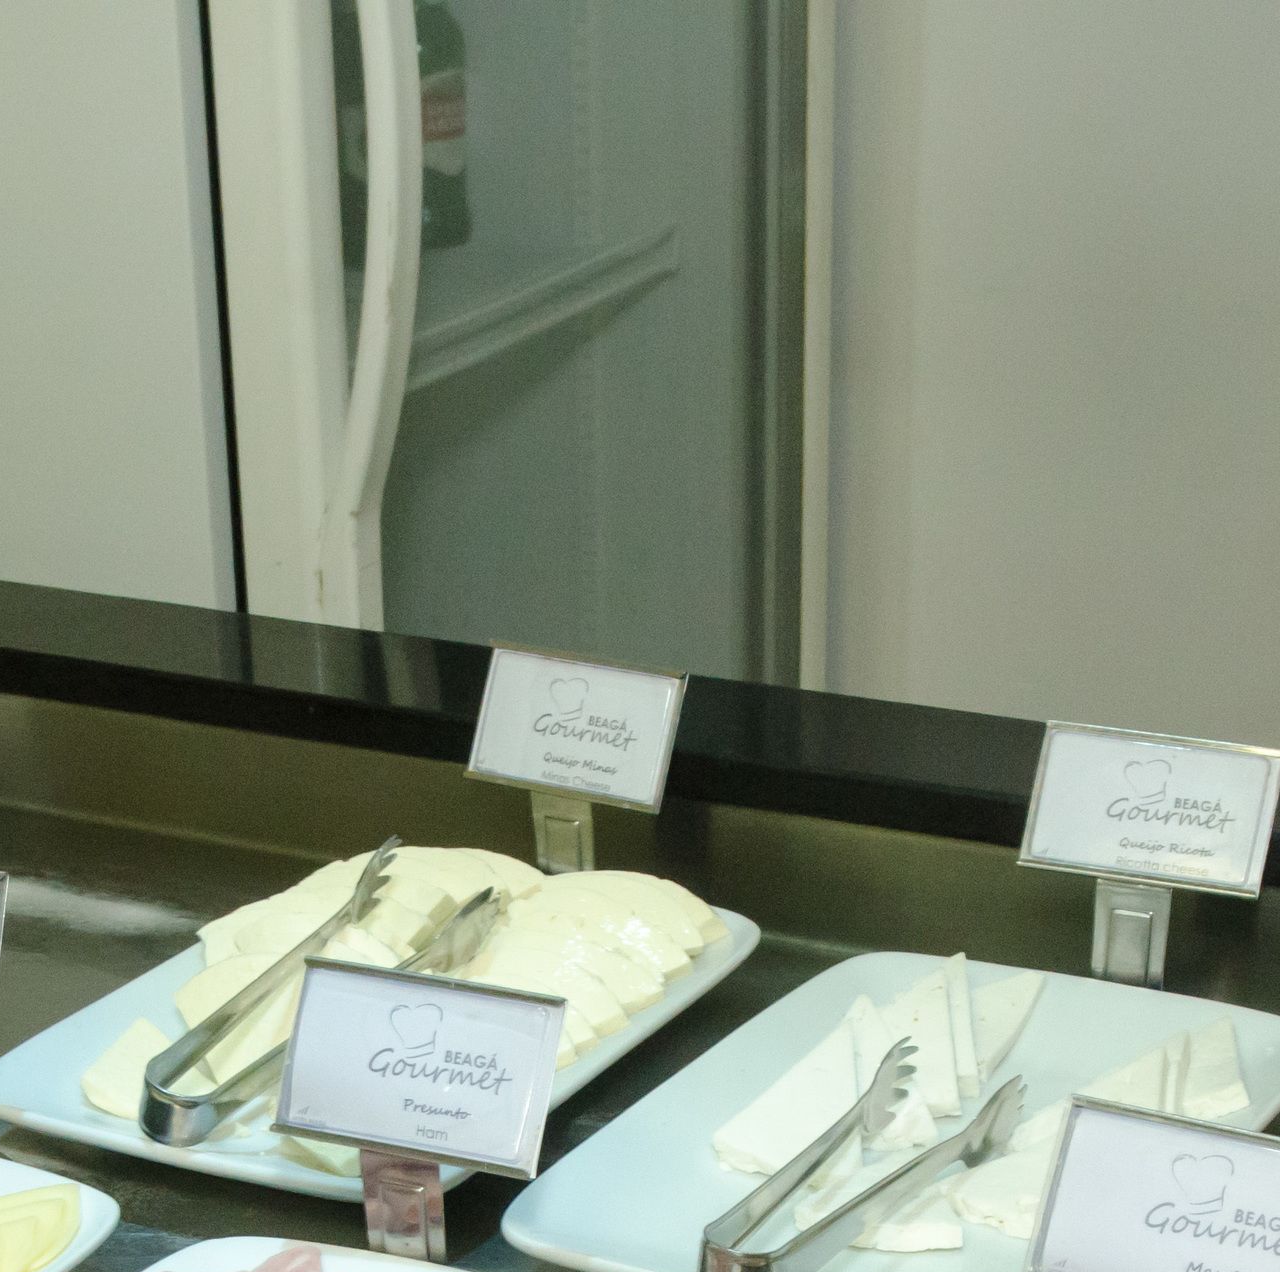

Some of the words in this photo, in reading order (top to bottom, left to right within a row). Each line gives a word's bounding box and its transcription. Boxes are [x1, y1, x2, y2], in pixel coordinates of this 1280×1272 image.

[533, 713, 638, 751] Gourmet
[543, 752, 580, 768] Queijo
[1174, 798, 1222, 813] BEAGÁ
[1106, 798, 1237, 834] Gourmet
[1119, 837, 1165, 854] Queijo
[1169, 843, 1216, 858] Ricota
[1115, 855, 1159, 872] Ricotta
[444, 1050, 498, 1070] BEAGÁ
[369, 1048, 512, 1095] Gourmet
[403, 1099, 472, 1120] Presunto
[416, 1125, 448, 1141] Ham
